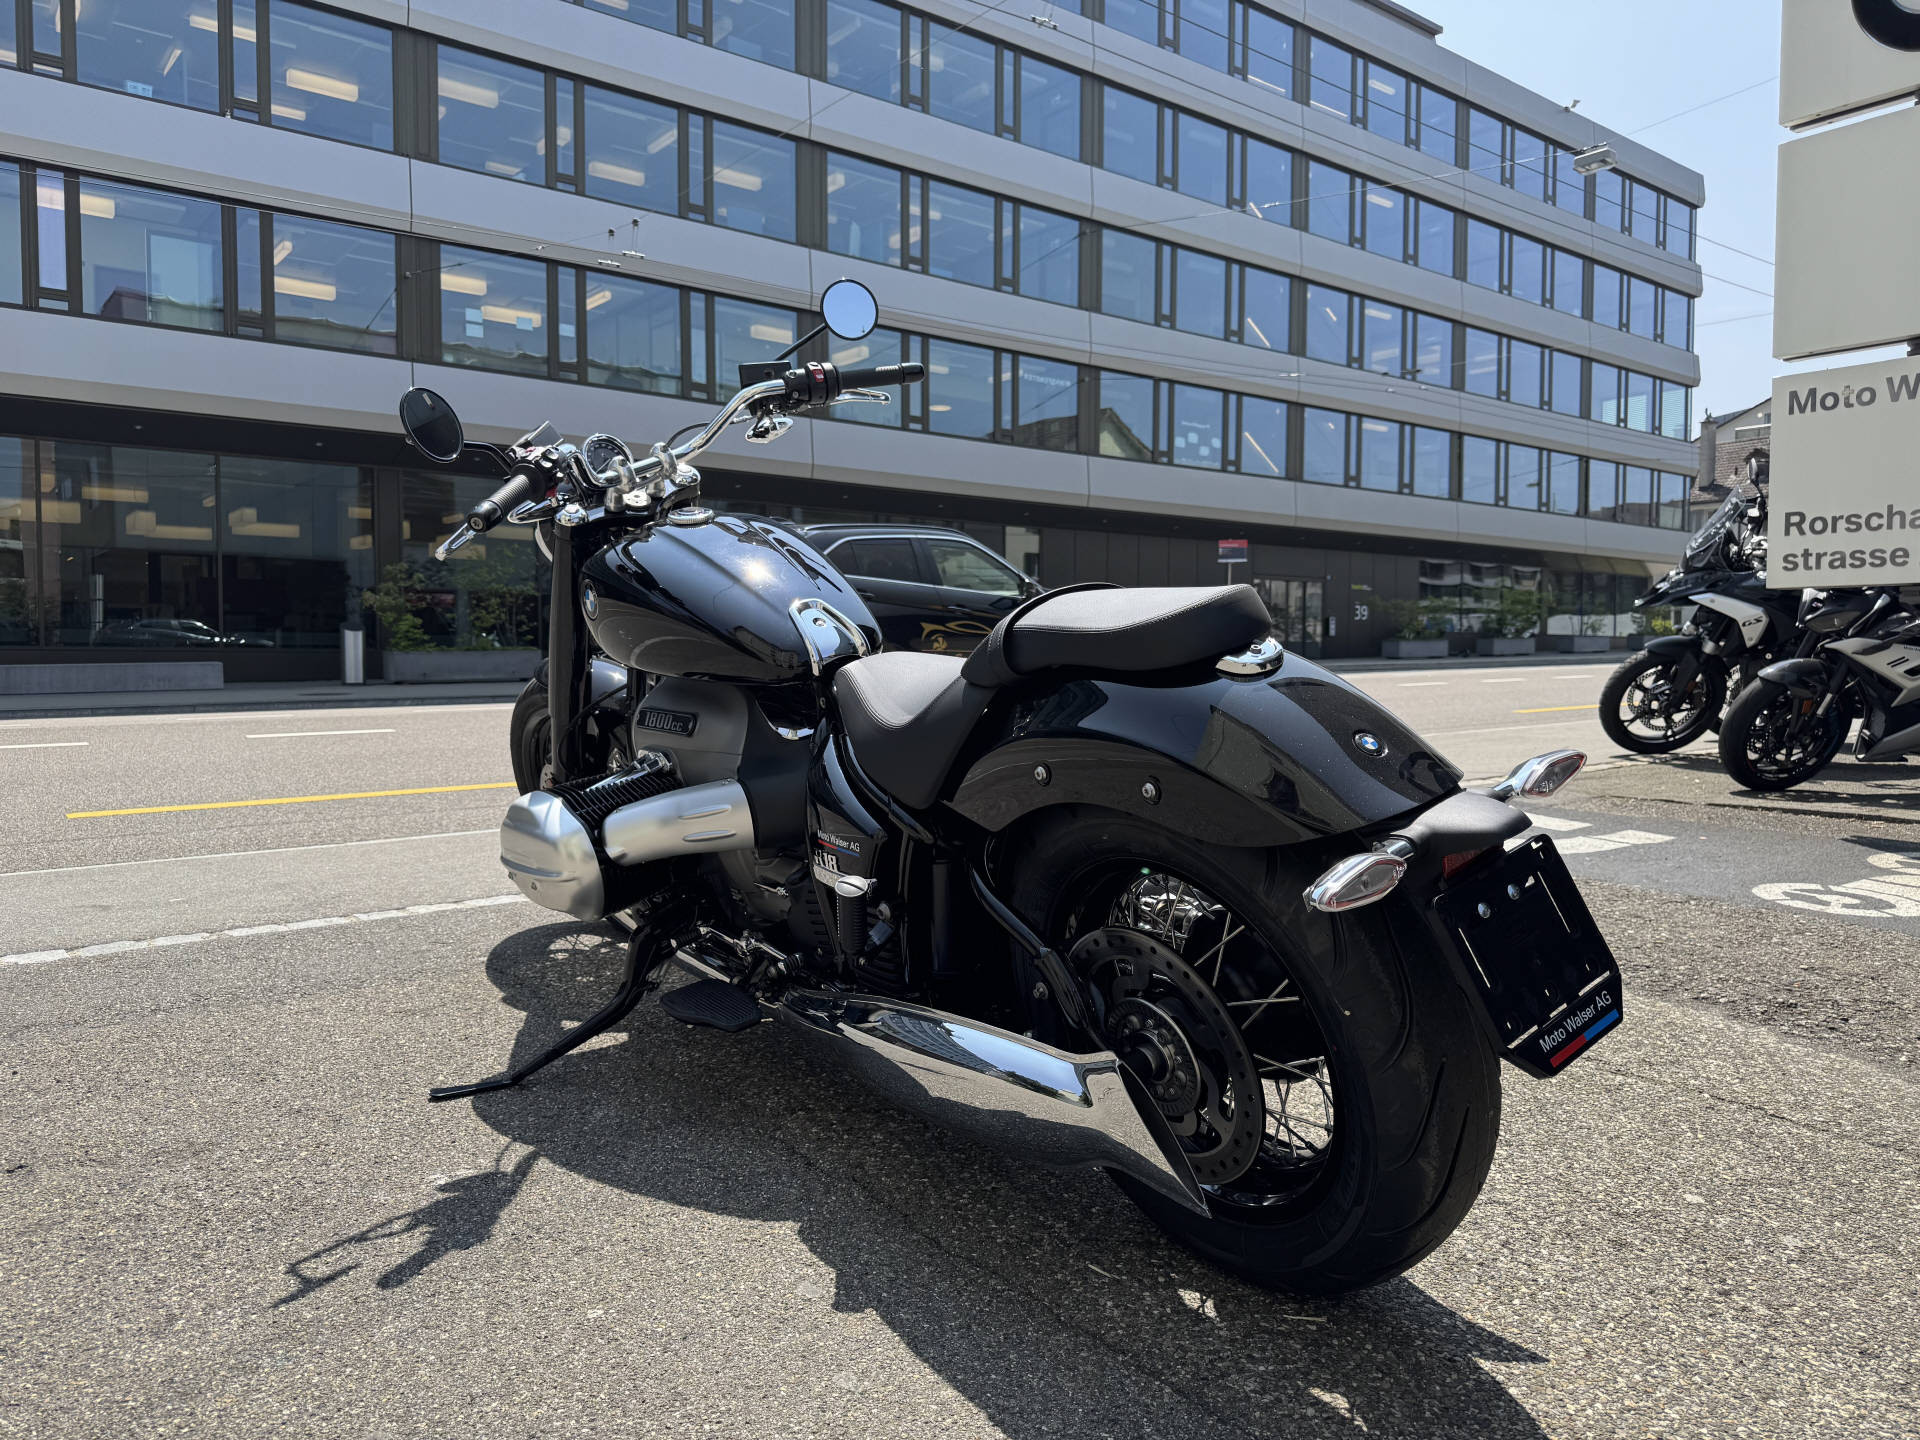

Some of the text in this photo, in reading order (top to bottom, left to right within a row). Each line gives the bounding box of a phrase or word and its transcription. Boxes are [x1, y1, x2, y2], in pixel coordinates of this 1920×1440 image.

[1788, 385, 1877, 415] Moto
[1781, 547, 1910, 572] strasse
[1354, 605, 1368, 620] 39
[829, 833, 849, 848] Walser
[850, 841, 860, 852] AG
[1539, 990, 1612, 1053] Moto Walser AG
